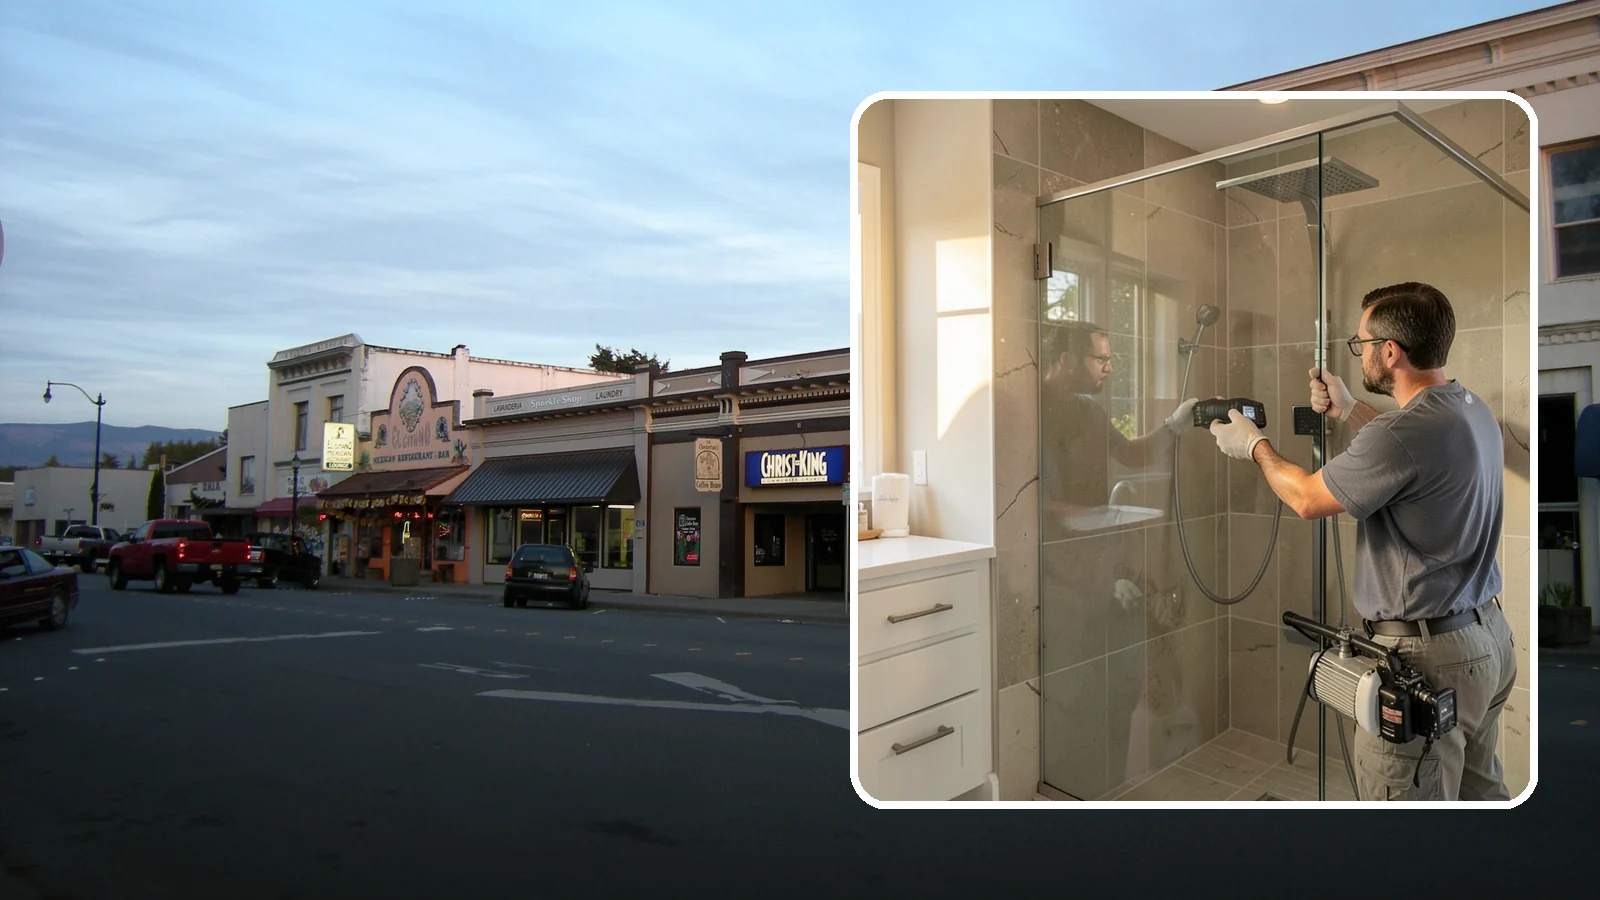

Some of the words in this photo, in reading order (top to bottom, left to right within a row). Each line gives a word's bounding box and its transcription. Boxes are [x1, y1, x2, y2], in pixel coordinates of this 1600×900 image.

[531, 397, 561, 409] Sparkle
[562, 394, 582, 404] Shop
[595, 389, 624, 400] LAUNDRY
[493, 402, 523, 412] LAVANDERIA
[374, 455, 396, 464] MEXICAN
[398, 451, 434, 462] RESTAURANT
[438, 450, 450, 459] BAR
[760, 452, 797, 478] CHRIST
[799, 449, 827, 476] KING
